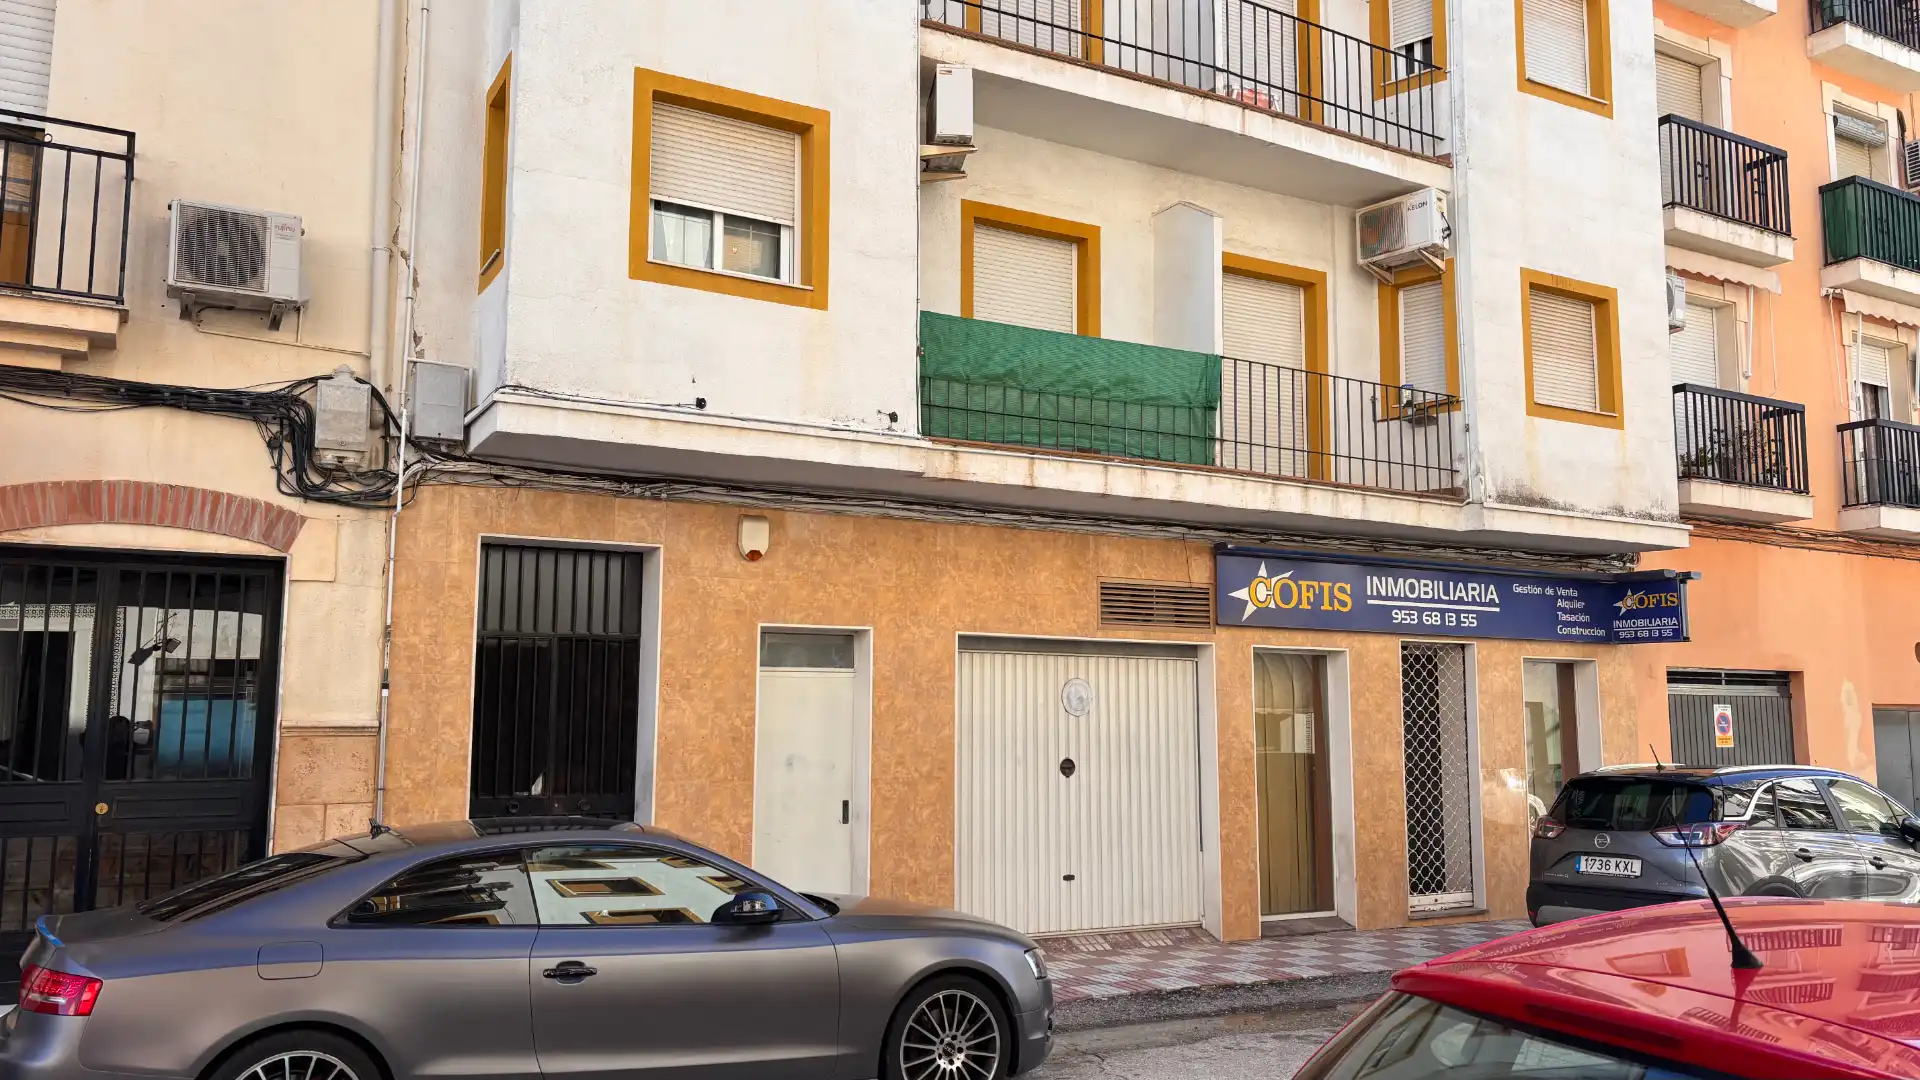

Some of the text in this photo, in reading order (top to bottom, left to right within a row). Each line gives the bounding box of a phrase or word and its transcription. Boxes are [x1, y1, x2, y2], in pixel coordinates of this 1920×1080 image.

[1249, 577, 1352, 612] COFIS
[1366, 575, 1499, 603] INMOBILIARIA
[1512, 583, 1578, 597] Gestión de Venta
[1557, 599, 1585, 610] Alquiler
[1622, 593, 1679, 609] COFIS
[1391, 609, 1478, 627] 953 68 13 55
[1557, 612, 1590, 622] Tasación
[1613, 617, 1678, 628] INMOBILIARIA
[1557, 625, 1606, 636] Construcción
[1619, 630, 1635, 638] 953
[1651, 629, 1659, 637] 13
[1661, 629, 1673, 637] 55
[1584, 857, 1637, 873] 1736 KXL
